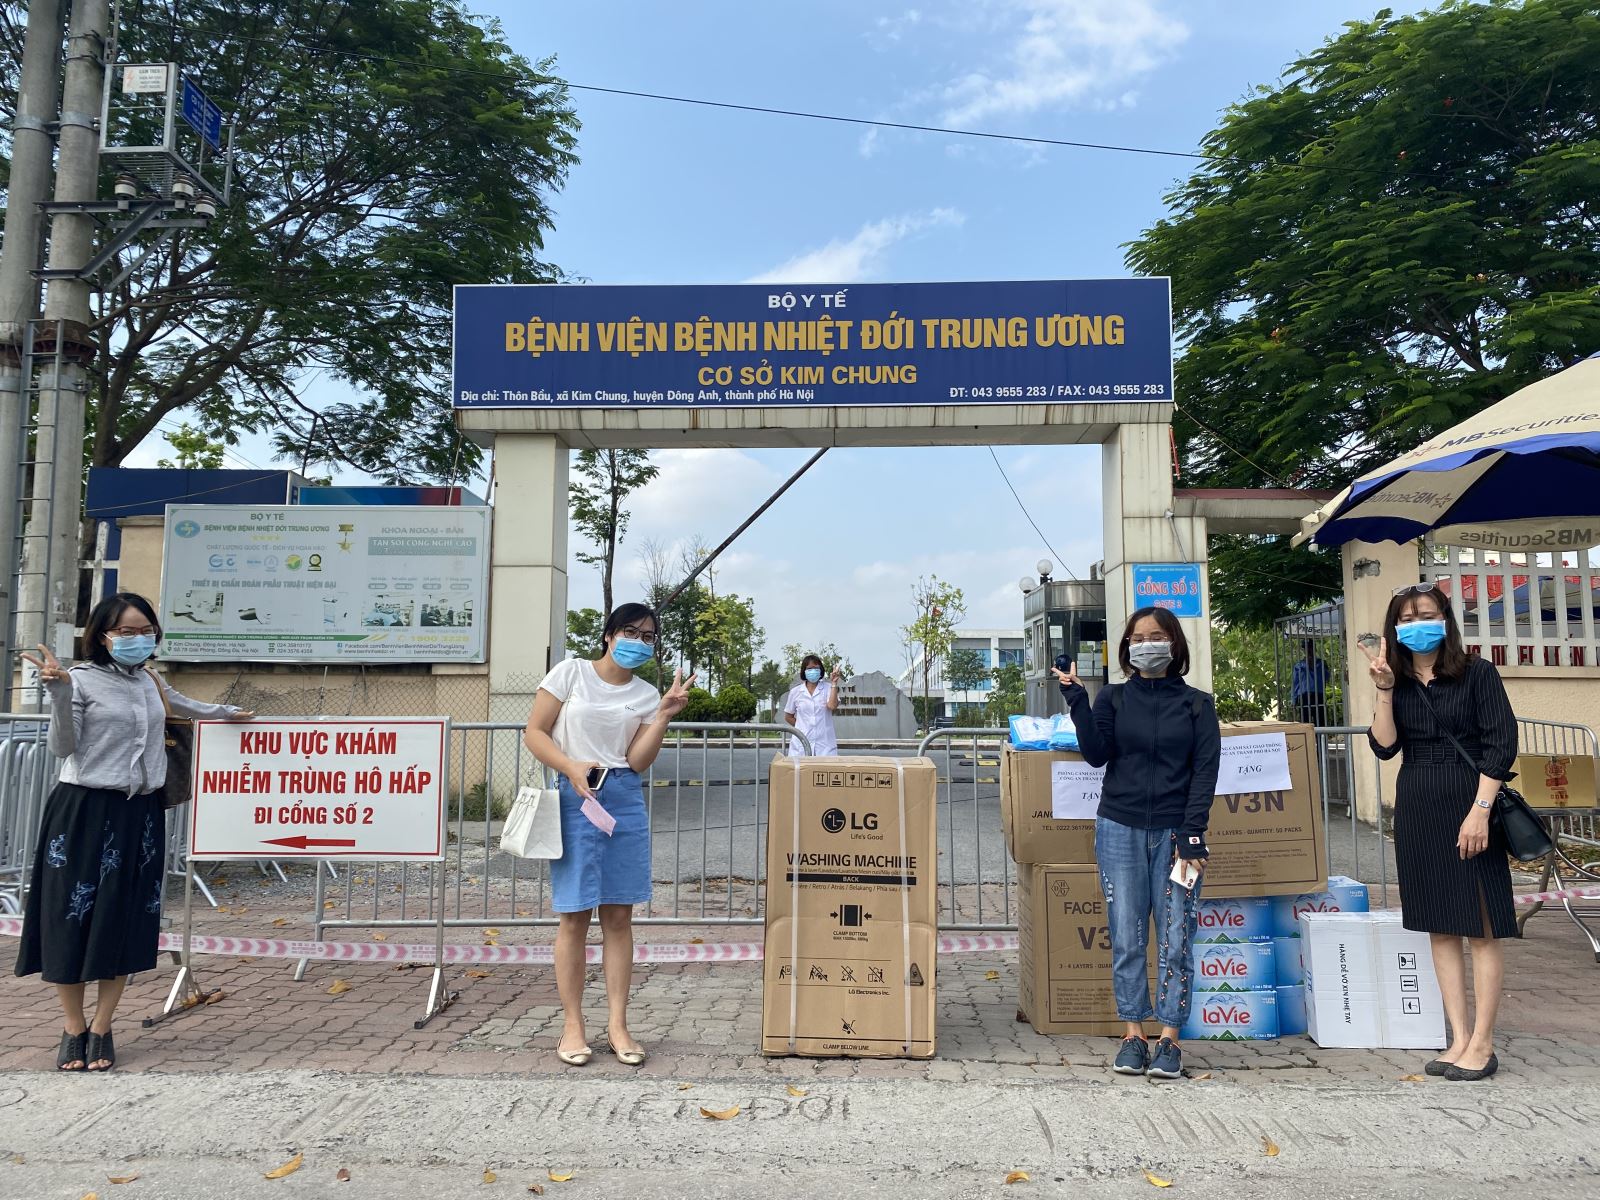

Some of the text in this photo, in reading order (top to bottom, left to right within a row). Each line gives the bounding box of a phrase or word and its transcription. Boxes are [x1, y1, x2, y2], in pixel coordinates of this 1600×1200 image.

[768, 289, 848, 311] BỘ Y TẾ
[505, 311, 1124, 358] BỆNH VIỆN BỆNH NHIỆT ĐỚI TRUNG ƯƠNG
[698, 360, 917, 386] CƠ SỞ KIM CHUNG
[460, 388, 814, 404] Địa chỉ: Thôn Bầu, xã Kim Chung, huyện Đông Anh, thành phố Hà Nội
[950, 388, 968, 398] ĐT:
[972, 387, 992, 398] 043
[996, 386, 1022, 397] 9555
[1026, 386, 1047, 397] 283
[1058, 386, 1086, 396] FAX:
[1088, 385, 1110, 396] 043
[1114, 384, 1140, 396] 9555
[1144, 384, 1164, 395] 283
[250, 513, 284, 521] BỘ Y TẾ
[1138, 576, 1198, 595] CỔNG SỐ 3
[240, 728, 397, 759] KHU VỰC KHÁM
[202, 763, 431, 794] NHIỄM TRÙNG HÔ HẤP
[1082, 792, 1100, 801] TẶN
[1224, 791, 1284, 813] V3N
[254, 800, 374, 824] ĐI CỔNG SỐ 2
[851, 812, 878, 830] LG
[786, 853, 851, 866] WASHING
[1064, 902, 1101, 914] FACE
[1198, 909, 1245, 927] laVie
[1077, 927, 1113, 950] V3
[1201, 958, 1248, 977] laVie
[1203, 1006, 1251, 1024] laVie
